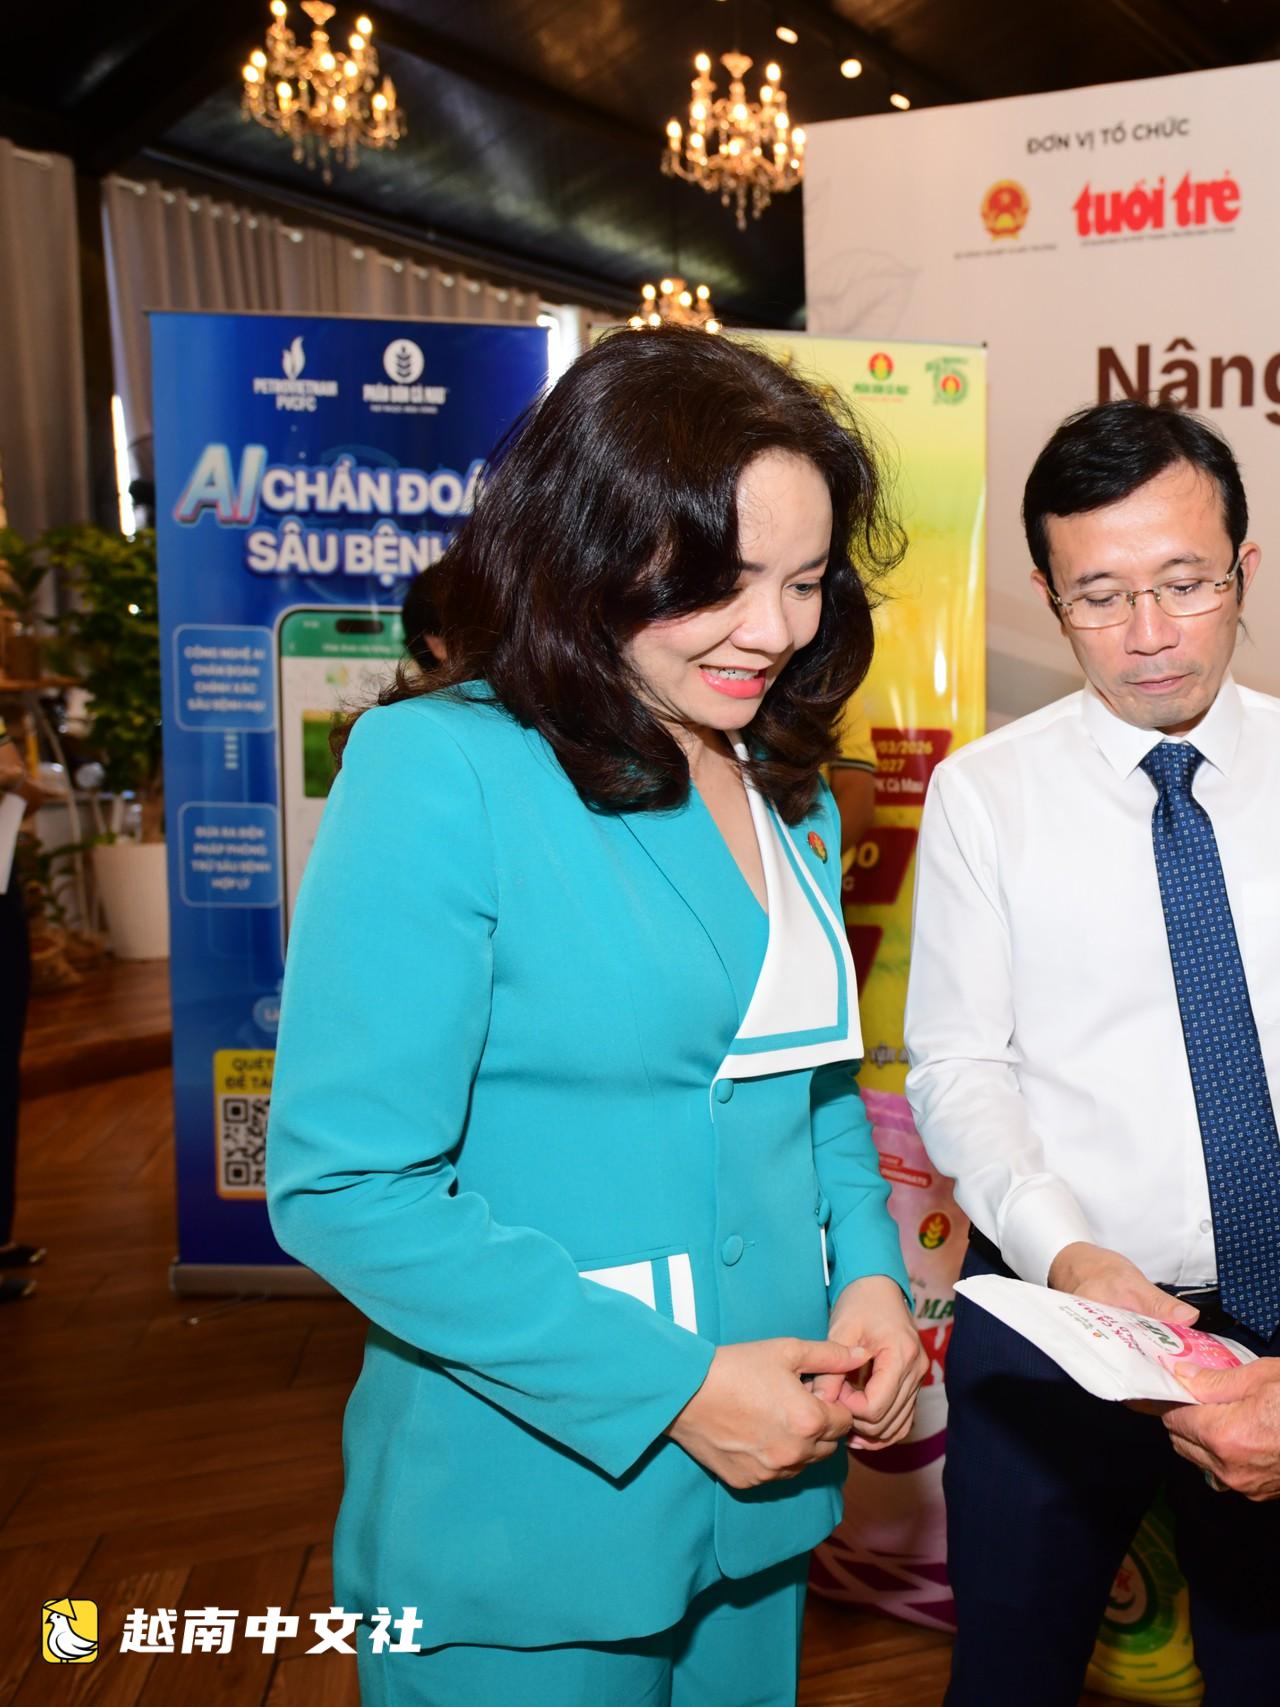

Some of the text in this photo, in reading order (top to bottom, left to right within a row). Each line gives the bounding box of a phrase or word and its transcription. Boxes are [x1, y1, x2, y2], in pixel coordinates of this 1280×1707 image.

[1027, 133, 1069, 154] ĐƠN
[1075, 132, 1094, 150] VỊ
[1133, 117, 1189, 141] CHỨC
[175, 445, 266, 525] AI
[262, 456, 390, 512] CHẨN
[248, 521, 338, 573] SÂU
